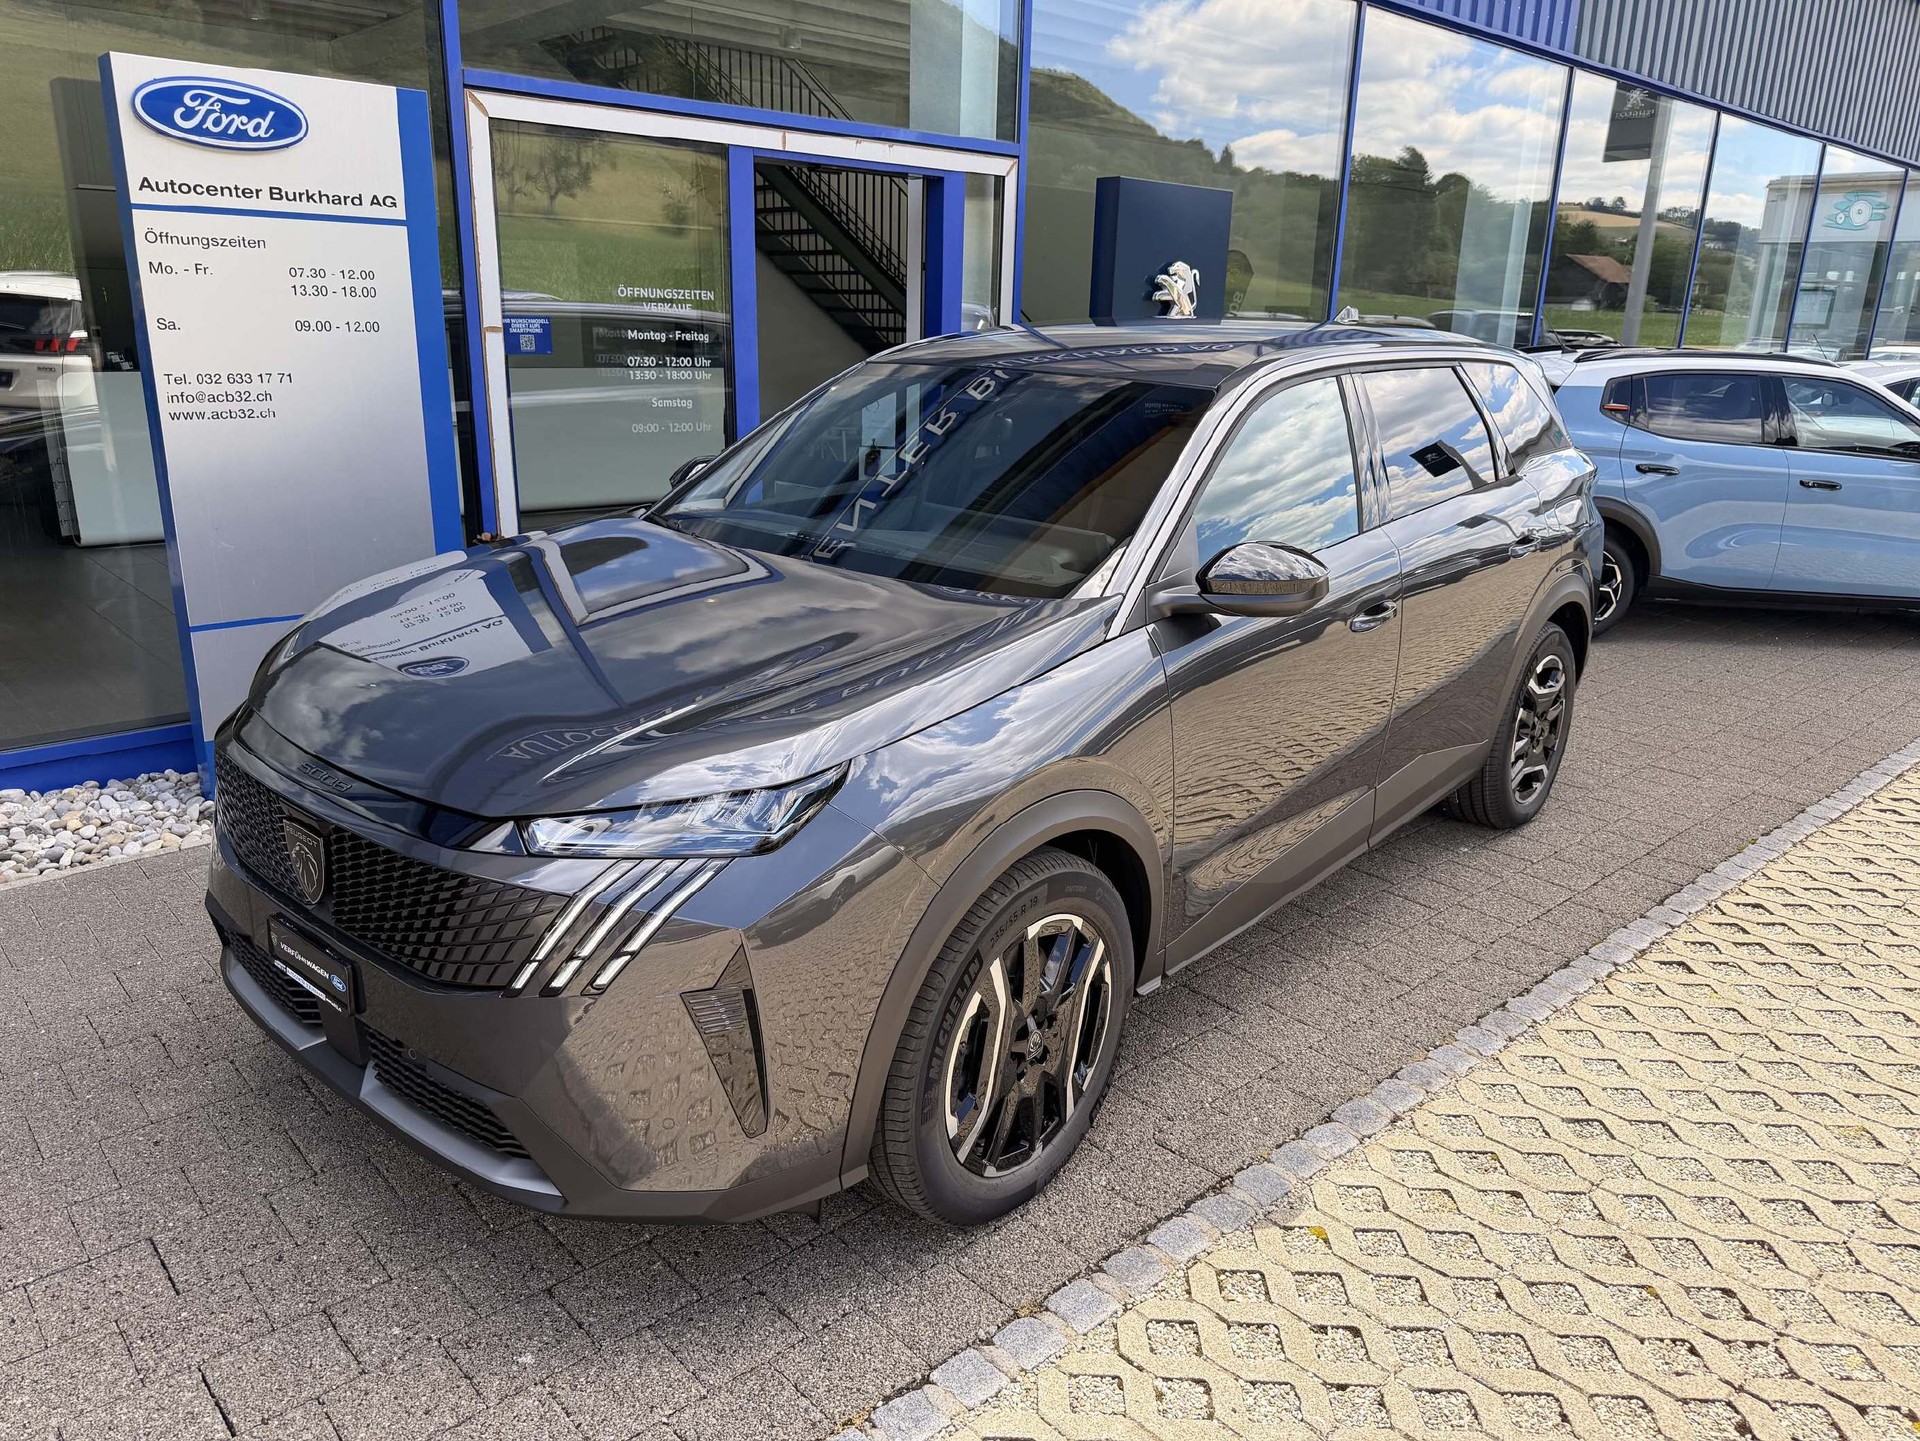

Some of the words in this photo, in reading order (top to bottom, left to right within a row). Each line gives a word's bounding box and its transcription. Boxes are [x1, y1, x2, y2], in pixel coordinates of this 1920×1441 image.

[173, 88, 275, 139] Ford
[138, 176, 263, 201] Autocenter
[269, 186, 364, 208] Burkhard
[369, 193, 398, 209] AG
[144, 227, 267, 250] Öffnungszeiten
[148, 261, 179, 275] Mo.
[194, 263, 214, 276] Fr.
[288, 267, 327, 280] 07.30
[339, 269, 376, 281] 12.00
[291, 285, 329, 298] 13.30
[341, 286, 377, 299] 18.00
[617, 284, 715, 301] ÖFFNUNGSZEITEN
[643, 302, 692, 314] VERKAUF
[156, 317, 182, 331] Sa.
[294, 320, 332, 333] 09.00
[345, 321, 380, 333] 12.00
[627, 329, 667, 343] Montag
[675, 330, 710, 343] Freitag
[627, 356, 657, 367] 07:30
[665, 357, 692, 367] 12:00
[694, 357, 711, 367] Uhr
[164, 373, 192, 385] Tel.
[196, 373, 223, 385] 032
[226, 373, 253, 385] 633
[257, 373, 273, 384] 17
[277, 372, 293, 384] 71
[629, 370, 657, 380] 13:30
[666, 370, 693, 380] 18:00
[694, 370, 712, 380] Uhr
[166, 390, 273, 404] info@acb32.ch
[651, 397, 693, 409] Samstag
[169, 408, 276, 421] www.acb32.ch
[632, 423, 659, 433] 09:00
[669, 423, 693, 433] 12:00
[696, 422, 712, 432] Uhr
[297, 761, 353, 792] 5008
[285, 825, 318, 848] PEUGEOT
[1020, 904, 1027, 914] R
[928, 957, 981, 1079] MICHELIN
